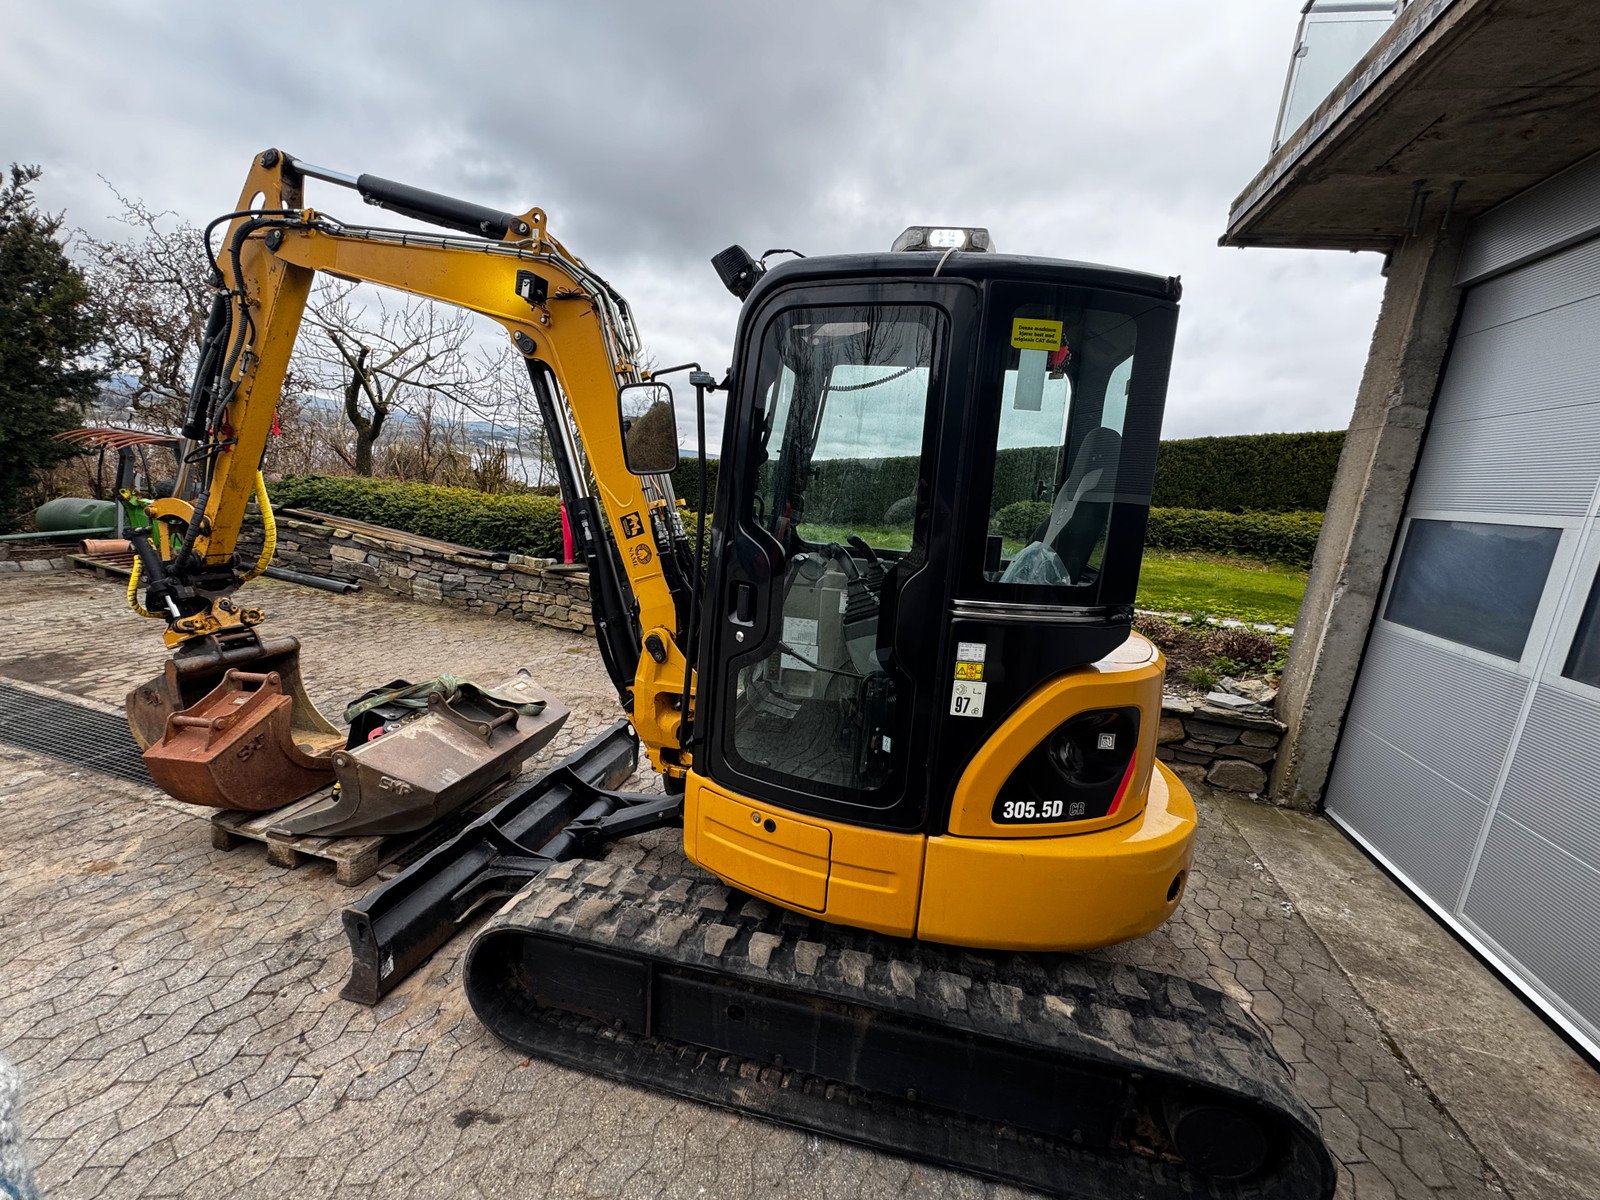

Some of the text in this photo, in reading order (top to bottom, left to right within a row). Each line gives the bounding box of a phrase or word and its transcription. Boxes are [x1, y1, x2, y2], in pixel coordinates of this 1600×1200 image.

[954, 696, 971, 714] 97
[1002, 800, 1086, 819] 305.5D CR
